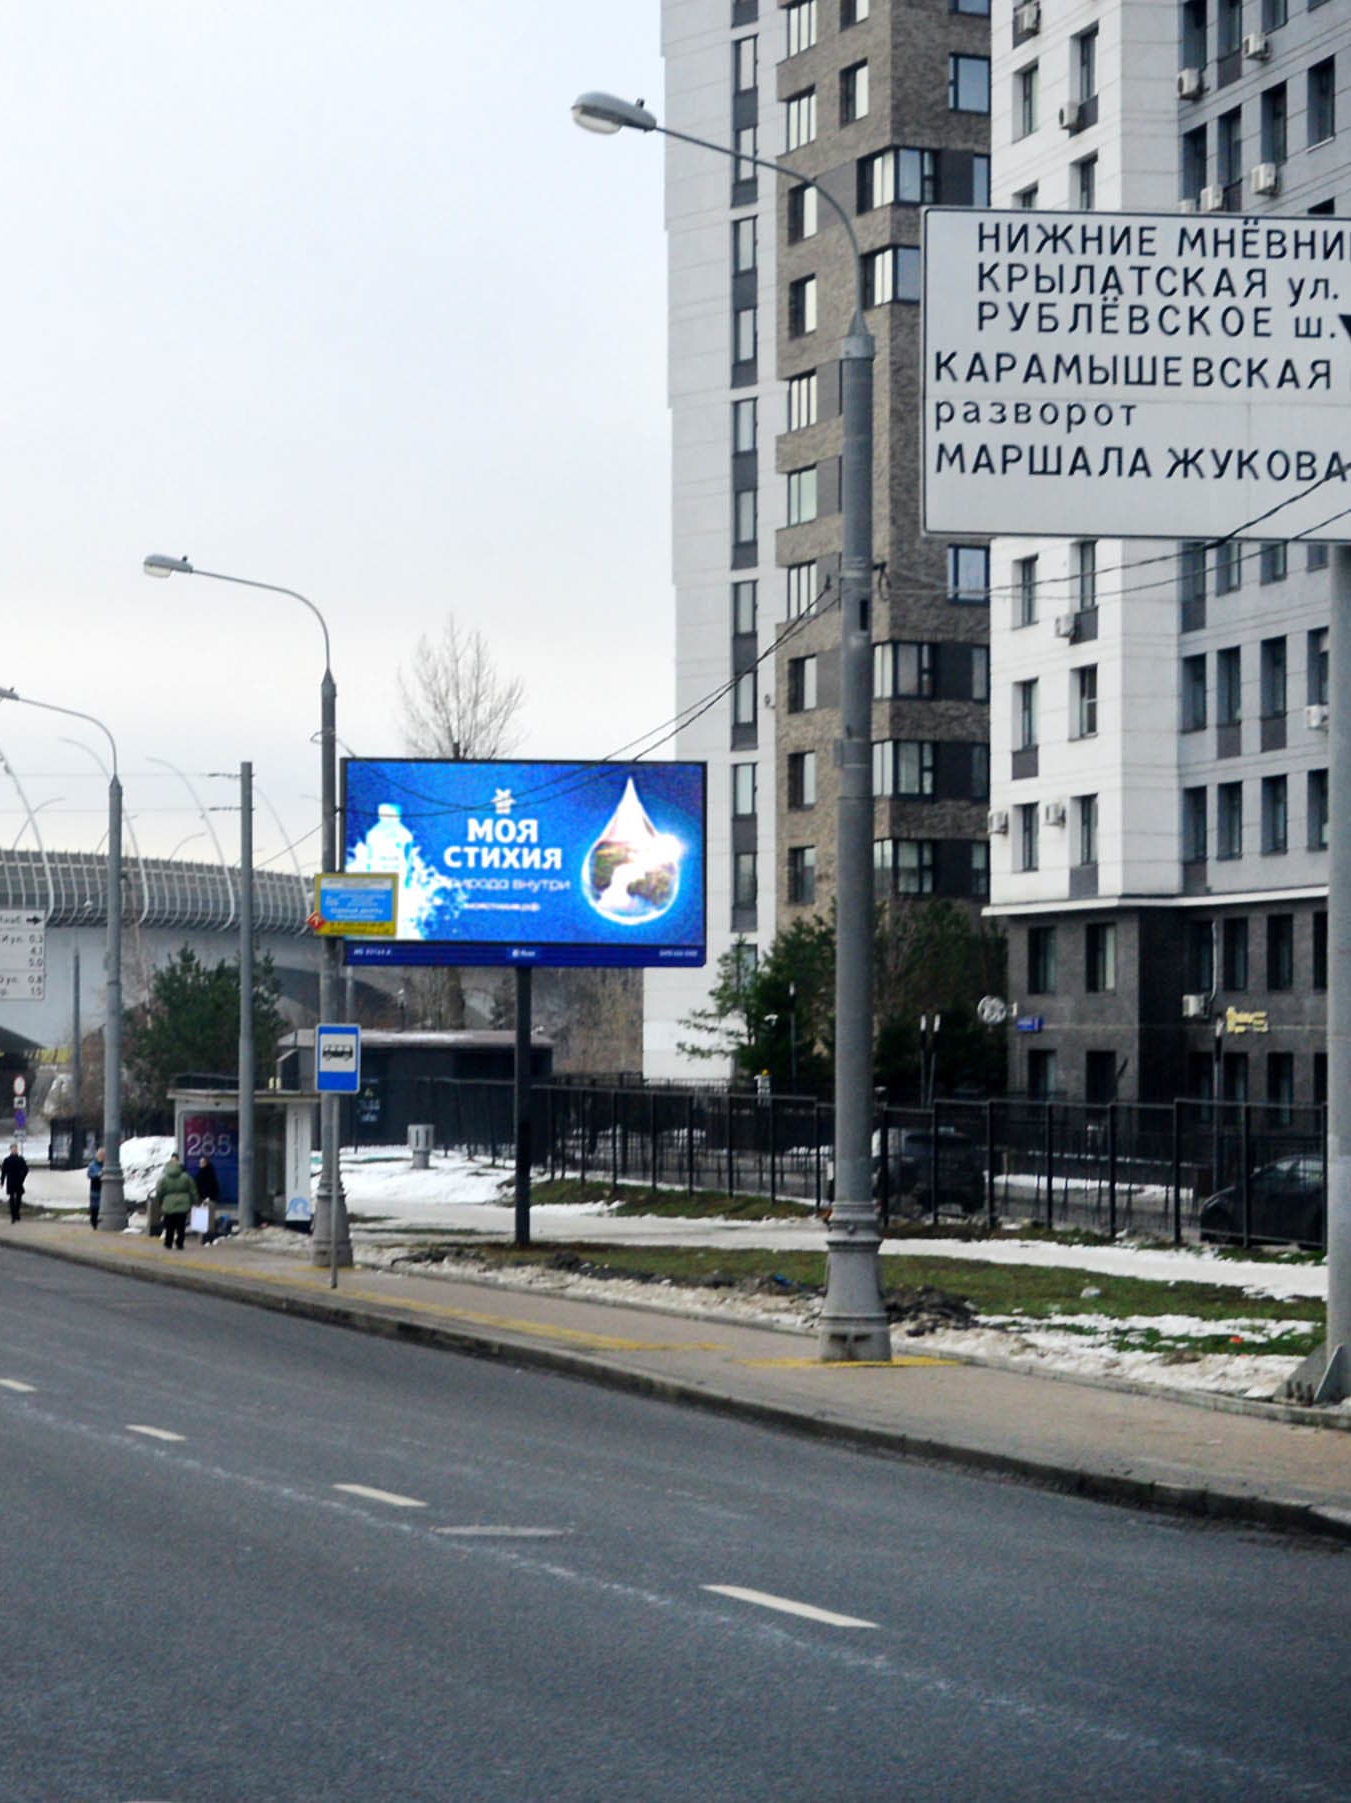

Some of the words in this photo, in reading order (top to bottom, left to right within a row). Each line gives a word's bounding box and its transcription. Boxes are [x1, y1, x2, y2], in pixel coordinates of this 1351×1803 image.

[977, 221, 1157, 257] НИЖНИЕ
[1177, 218, 1351, 261] МНЁВНИ
[977, 262, 1267, 299] КРЫЛАТСКАЯ
[1287, 276, 1339, 308] ул.
[977, 296, 1272, 338] РУБЛЁВСКОЕ
[1294, 315, 1336, 339] ш.
[935, 351, 1332, 390] КАРАМЫШЕВСКАЯ
[935, 401, 1138, 434] разворот
[935, 443, 1152, 478] МАРШАЛА
[1165, 447, 1348, 482] ЖУКОВА
[466, 818, 539, 843] МОЯ
[443, 845, 563, 870] СТИХИЯ
